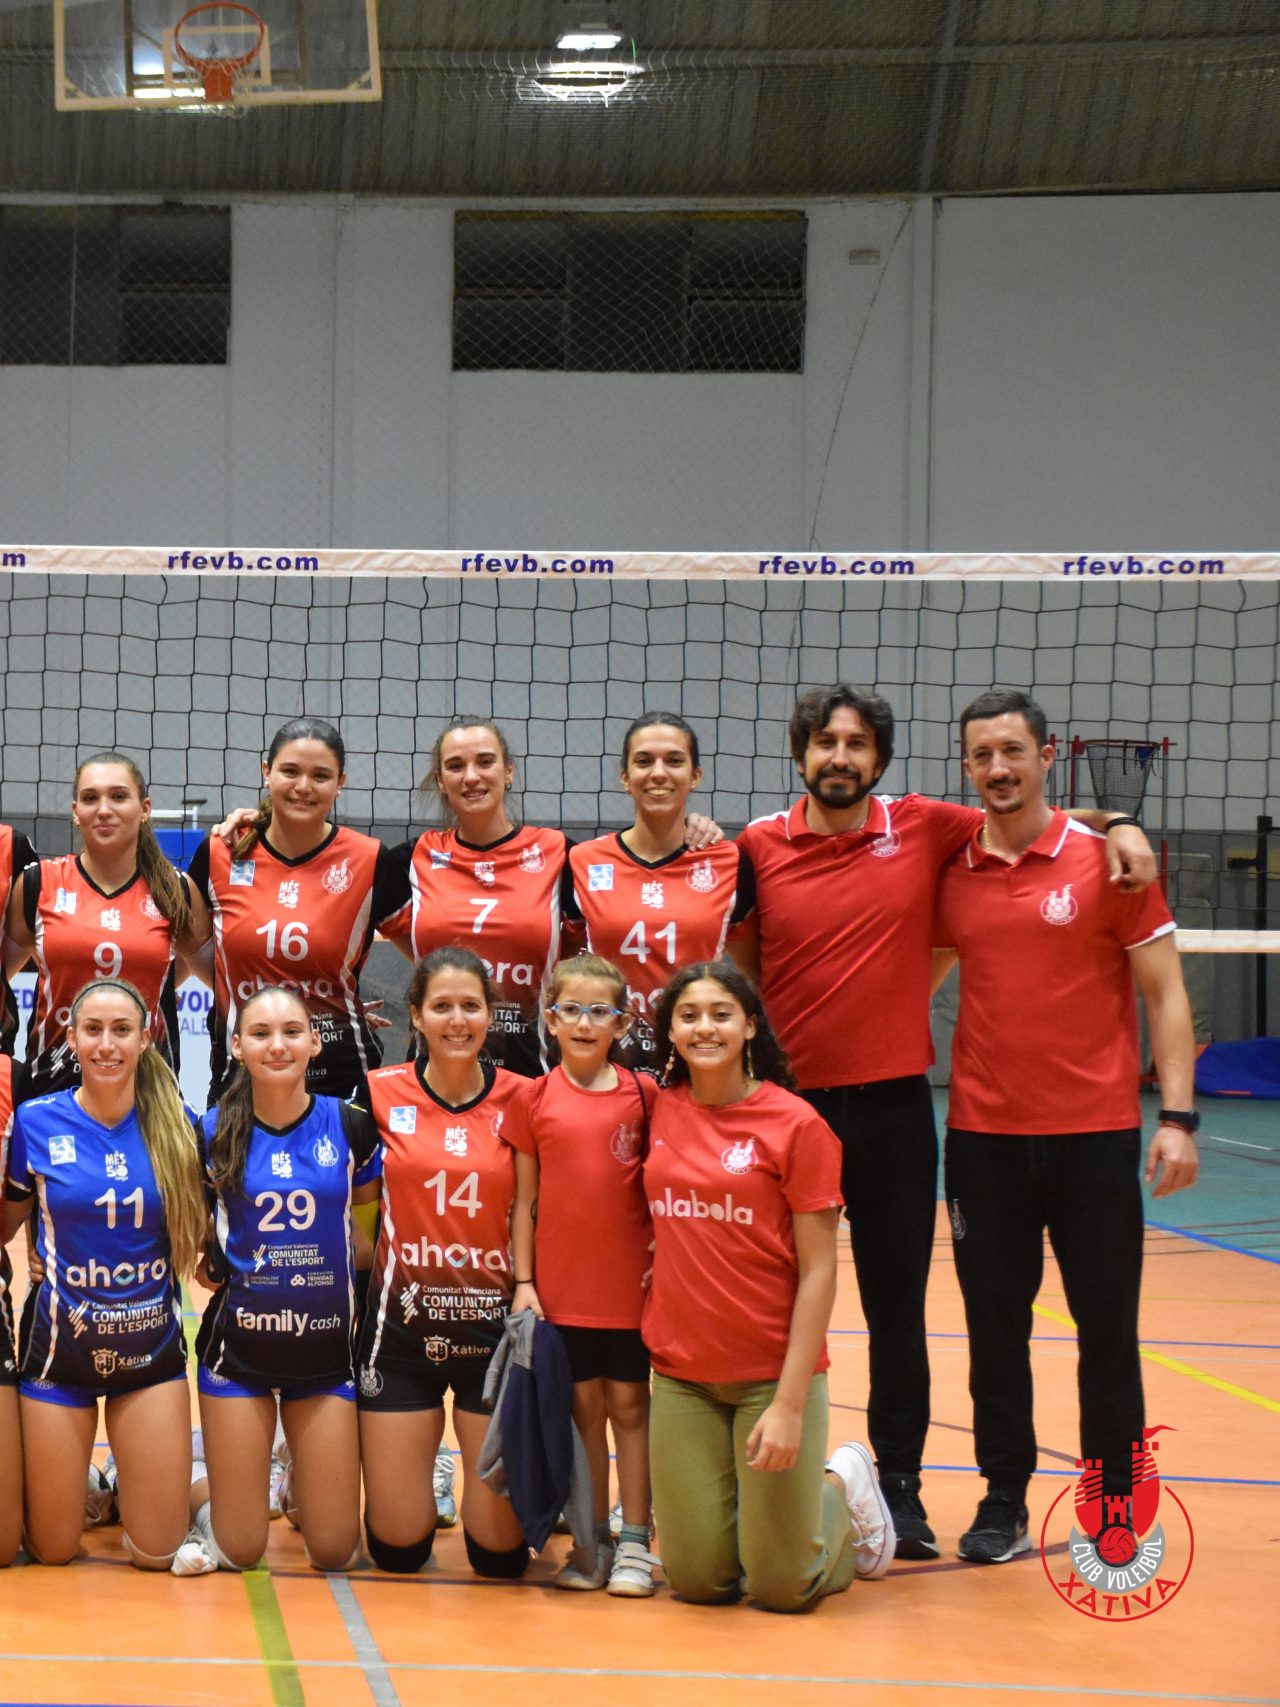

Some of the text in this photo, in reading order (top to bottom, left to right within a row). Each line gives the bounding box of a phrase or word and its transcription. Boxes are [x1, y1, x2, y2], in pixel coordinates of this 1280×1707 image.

[167, 549, 320, 572] rfevb.com
[461, 552, 615, 575] rfevb.com
[758, 555, 916, 576] rfevb.com
[1063, 555, 1226, 576] rfevb.com
[469, 898, 499, 934] 7
[256, 918, 310, 961] 16
[619, 920, 677, 965] 41
[93, 941, 123, 980] 9
[237, 973, 334, 1001] ara
[488, 1021, 529, 1034] SPORT
[424, 1169, 483, 1219] 14
[94, 1186, 144, 1229] 11
[254, 1189, 316, 1232] 29
[268, 1249, 319, 1259] COMUNITAT
[271, 1256, 325, 1267] DE L'ESPORT
[401, 1236, 507, 1272] ahora
[66, 1257, 167, 1288] ahora
[422, 1285, 501, 1295] Comunitat Valenciana
[422, 1295, 502, 1308] COMUNITAT
[92, 1304, 164, 1324] COMUNITAT
[97, 1312, 169, 1335] DE L'ESPORT
[236, 1306, 341, 1337] family cash
[428, 1305, 508, 1321] DE L'ESPORT
